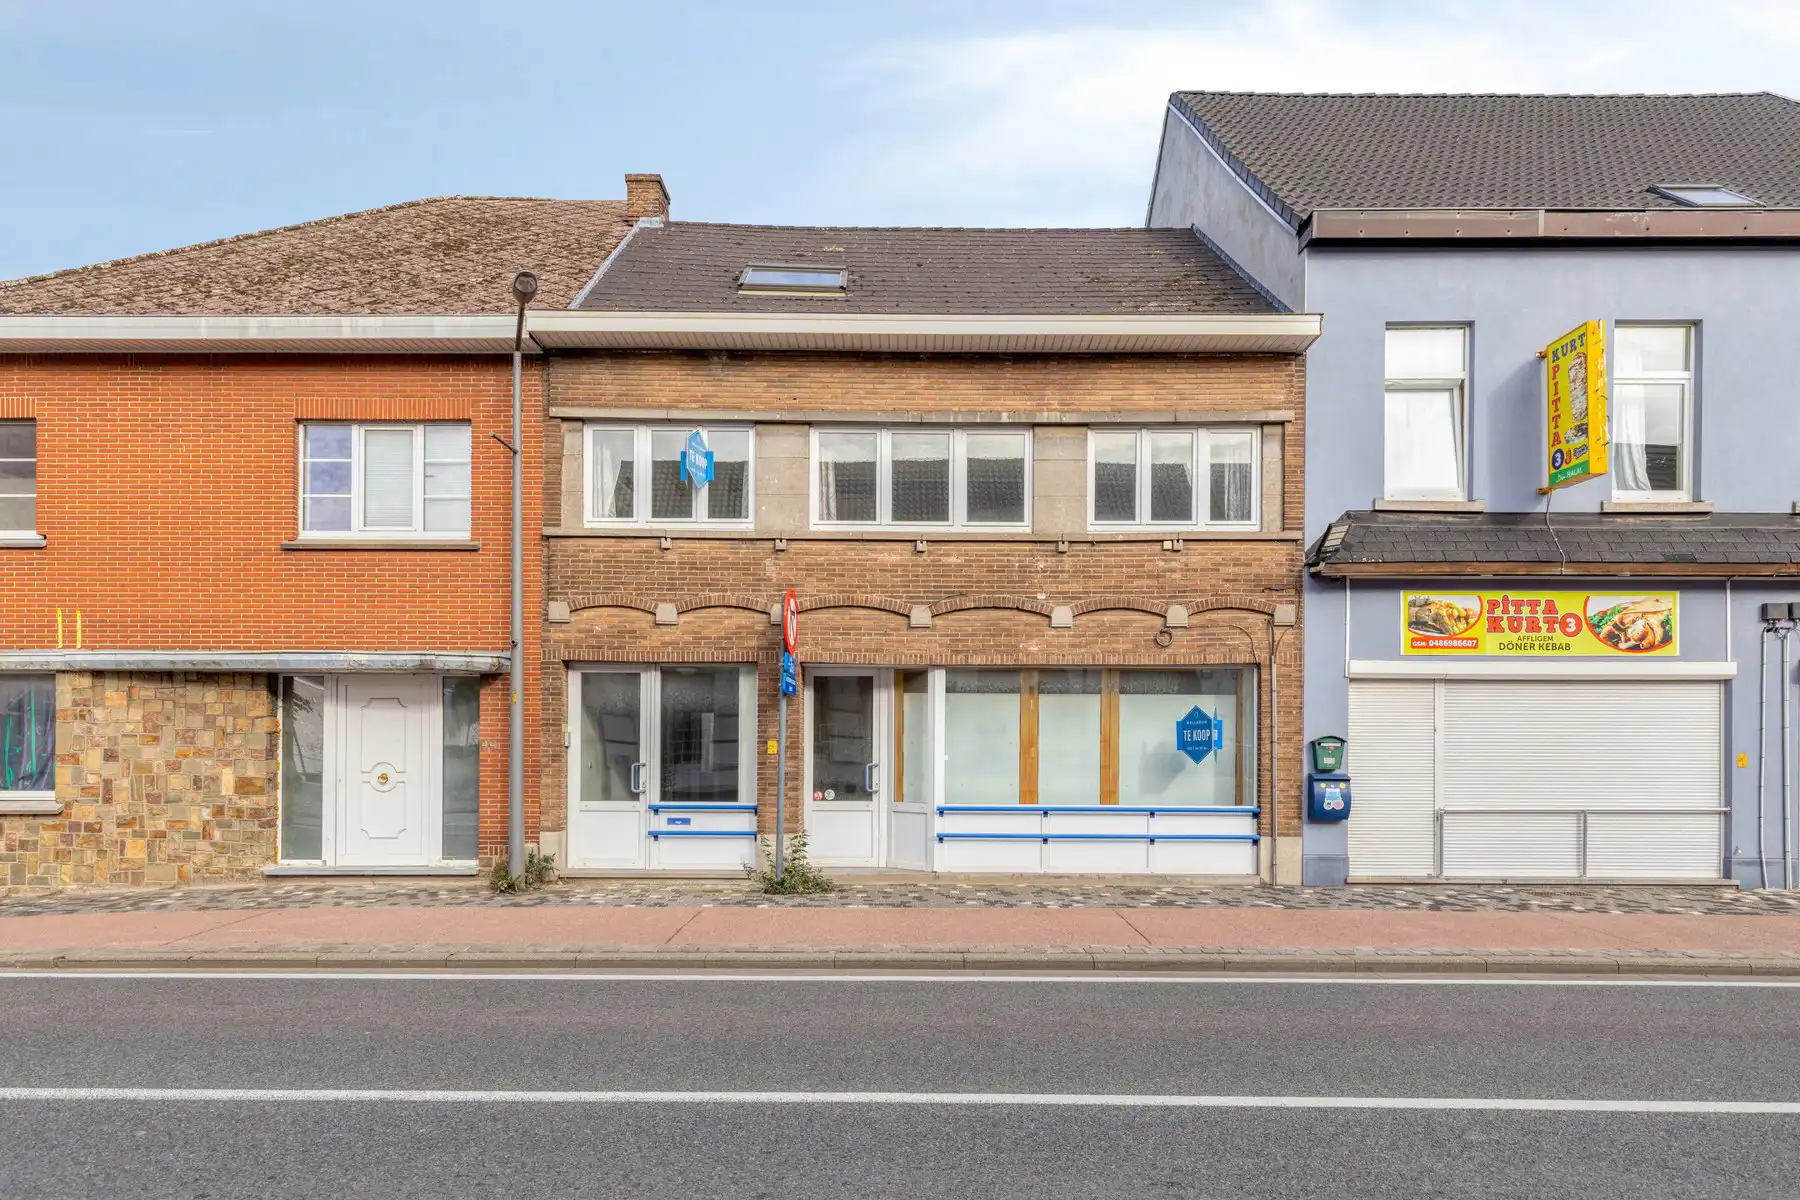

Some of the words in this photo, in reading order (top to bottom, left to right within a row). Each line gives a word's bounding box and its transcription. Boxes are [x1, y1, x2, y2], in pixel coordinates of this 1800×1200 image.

[1551, 332, 1586, 363] KURT
[1551, 364, 1562, 448] PITTA
[1554, 452, 1562, 467] 3
[1486, 616, 1559, 633] KURT
[1565, 617, 1577, 633] 3
[1498, 640, 1536, 651] DÖNER
[1538, 642, 1571, 651] KEBAB
[1183, 730, 1192, 742] TE
[1193, 729, 1211, 742] KOOP
